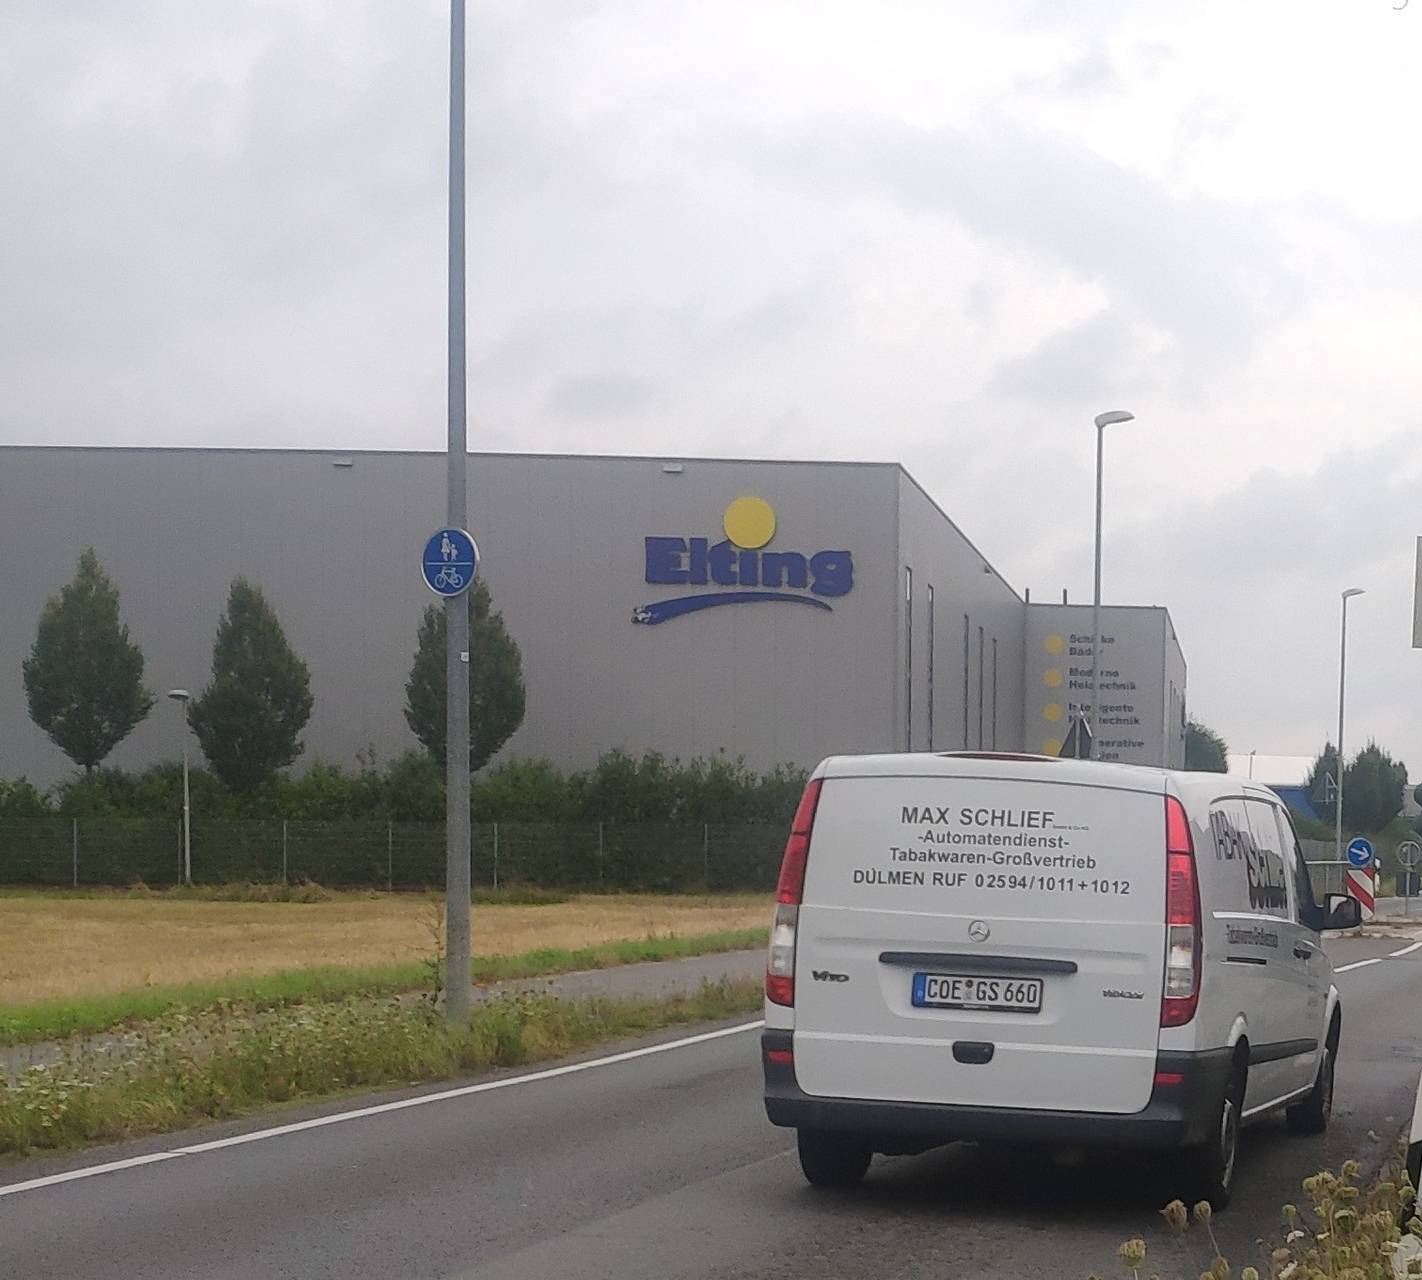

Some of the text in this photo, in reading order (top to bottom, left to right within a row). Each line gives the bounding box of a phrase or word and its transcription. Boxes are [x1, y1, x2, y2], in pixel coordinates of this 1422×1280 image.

[645, 536, 853, 597] Elting
[901, 807, 1055, 829] MAX SCHLIEF
[917, 830, 1070, 848] -Automatendienst-
[890, 848, 1096, 869] Tabakwaren-Großvertrieb
[932, 873, 968, 887] RUF
[927, 979, 1037, 1003] COE GS 660
